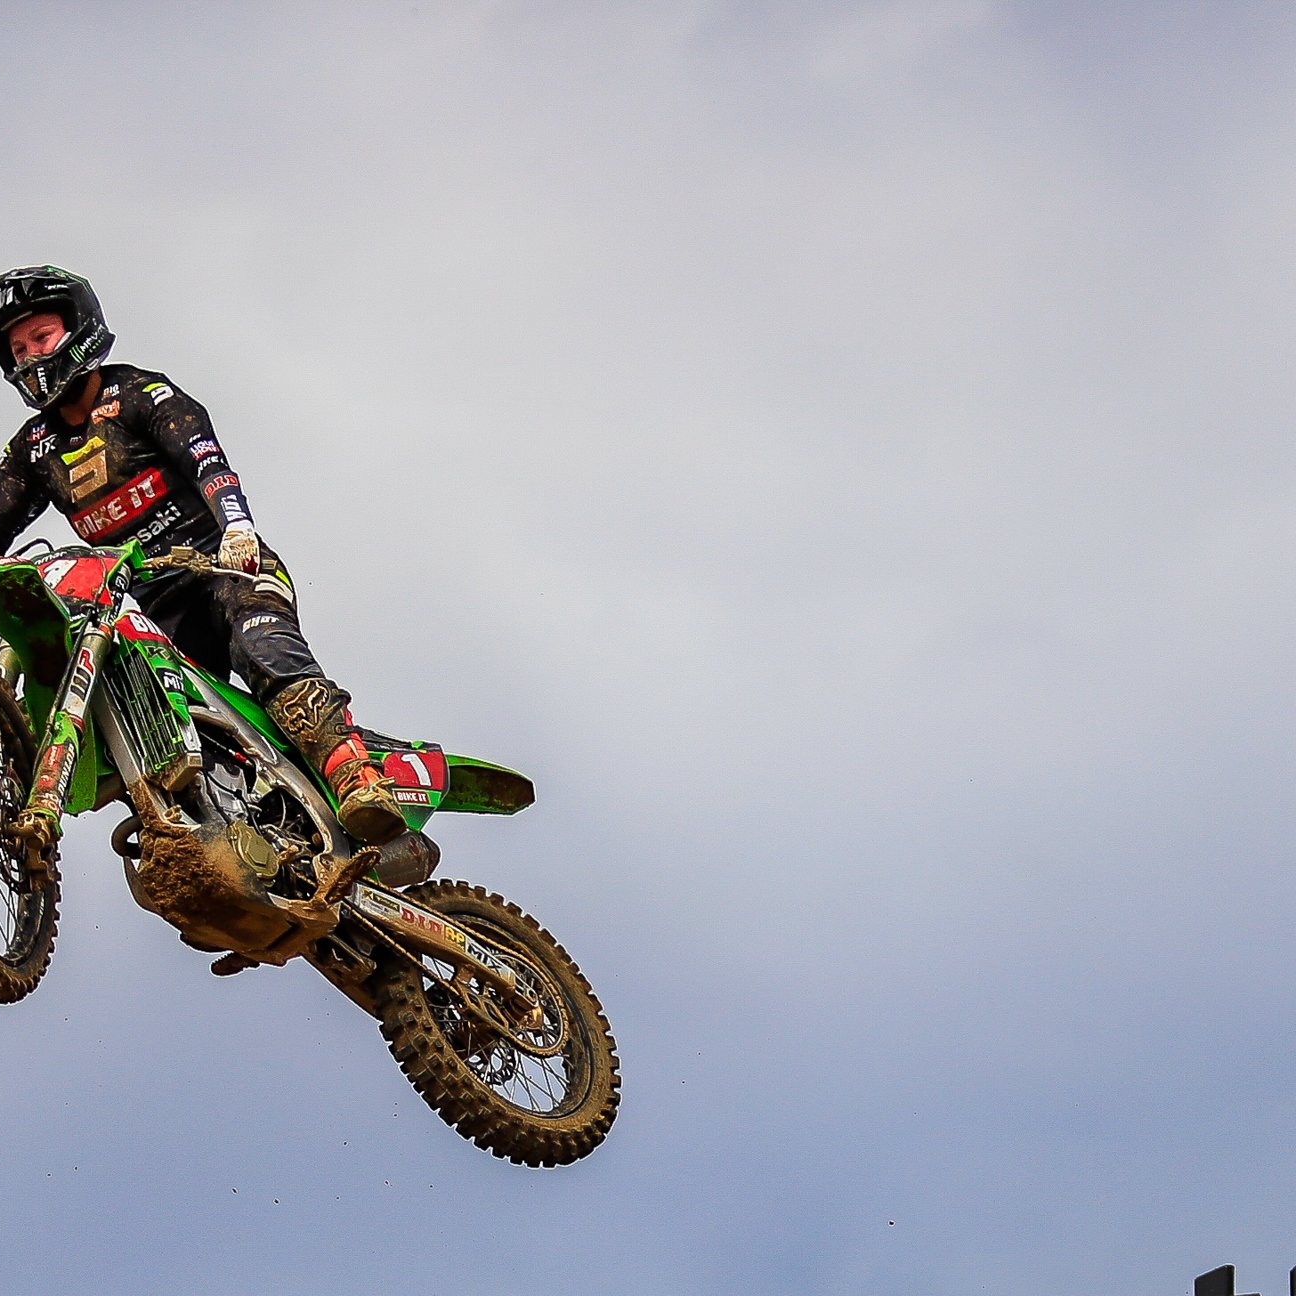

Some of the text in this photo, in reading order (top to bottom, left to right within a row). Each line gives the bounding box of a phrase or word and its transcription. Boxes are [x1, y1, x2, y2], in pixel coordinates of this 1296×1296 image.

[128, 474, 156, 509] IT
[57, 743, 75, 796] DUNLOP
[400, 753, 432, 787] 1
[396, 791, 427, 803] BIKE IT
